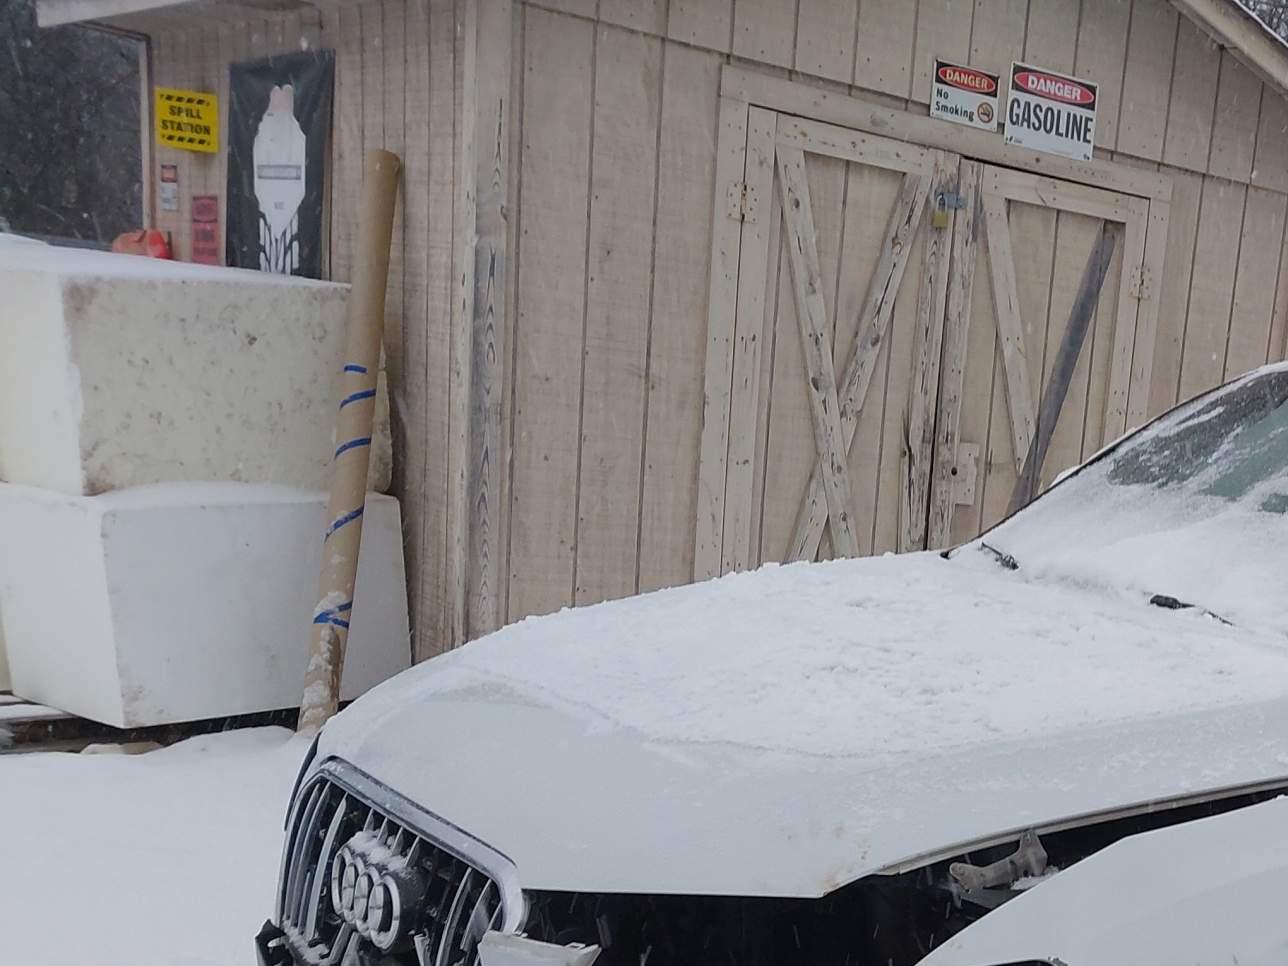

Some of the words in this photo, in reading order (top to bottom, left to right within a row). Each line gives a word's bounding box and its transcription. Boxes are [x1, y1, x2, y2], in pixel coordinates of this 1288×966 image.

[946, 69, 988, 89] DANGER
[1028, 75, 1081, 100] DANGER
[936, 88, 949, 100] No
[169, 105, 202, 120] SPILL
[935, 102, 975, 122] Smoking
[1009, 98, 1093, 144] GASOLINE
[161, 120, 211, 135] STATION
